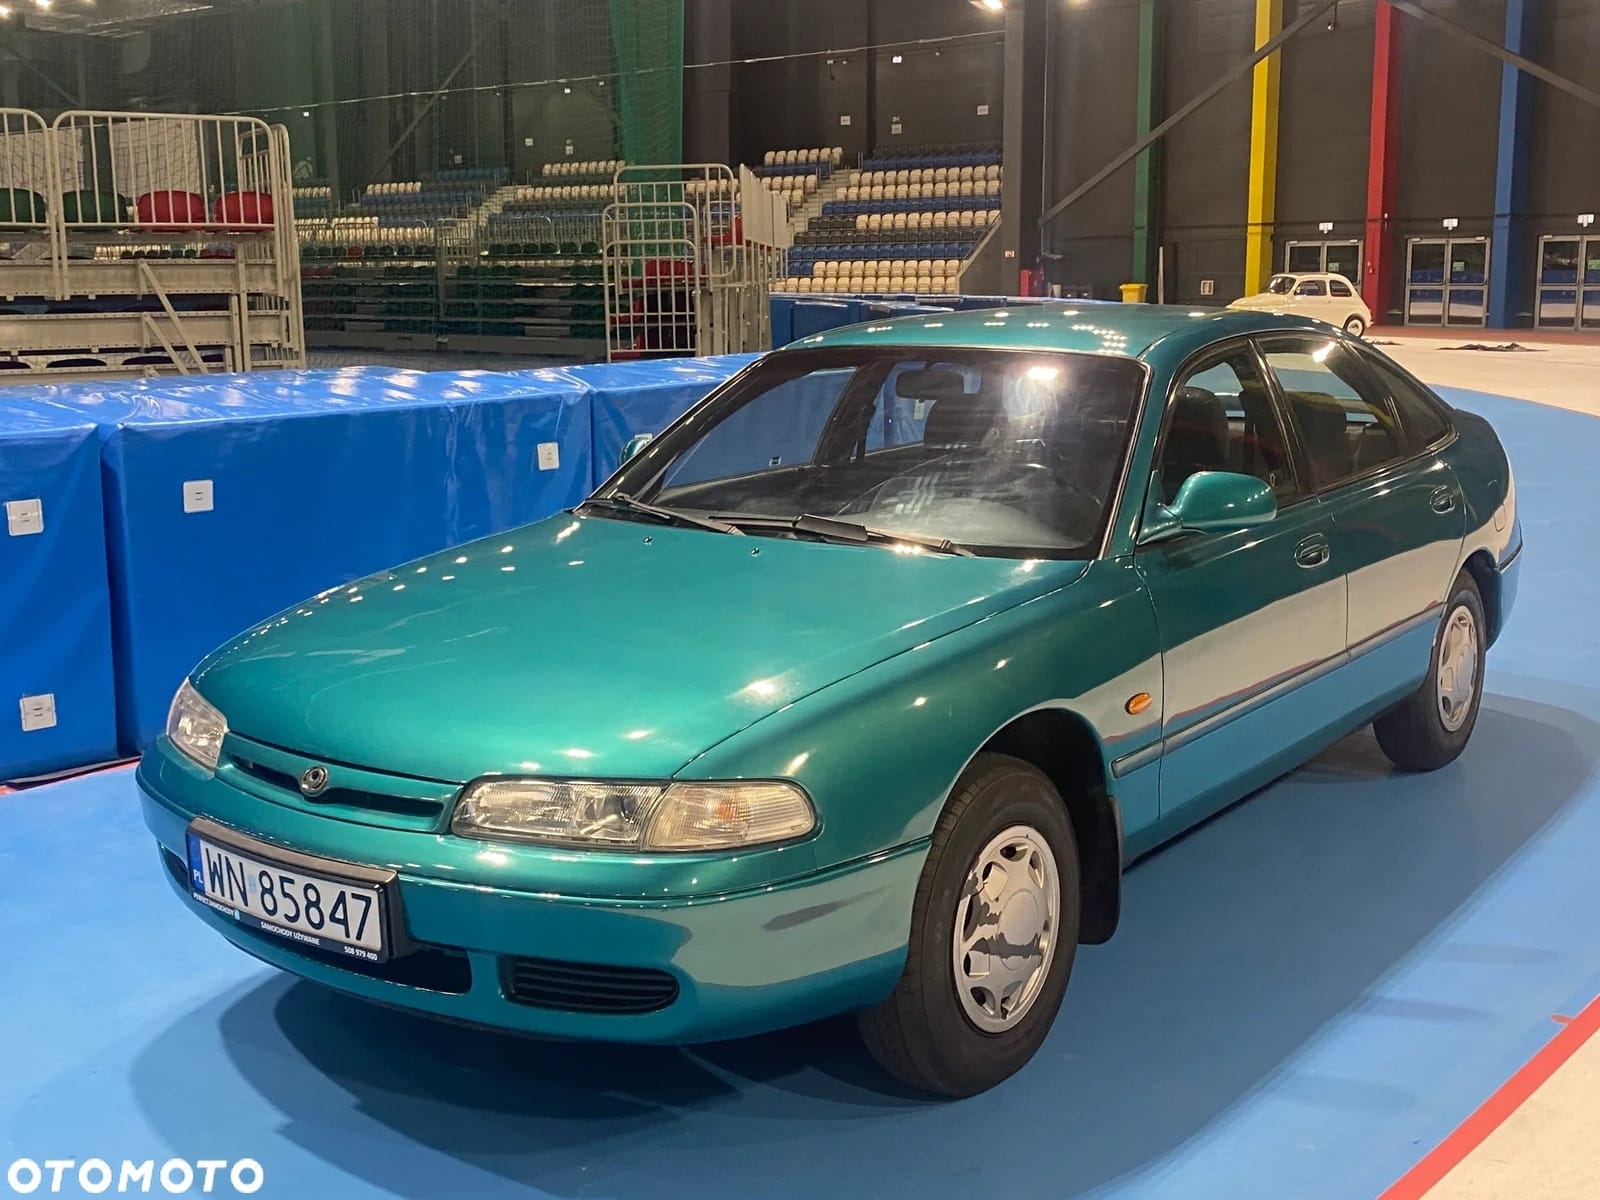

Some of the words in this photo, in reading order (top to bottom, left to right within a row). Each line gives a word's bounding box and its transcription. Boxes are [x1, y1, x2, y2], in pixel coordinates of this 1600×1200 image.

[193, 869, 204, 884] PL
[205, 847, 249, 908] WN
[259, 870, 372, 941] 85847
